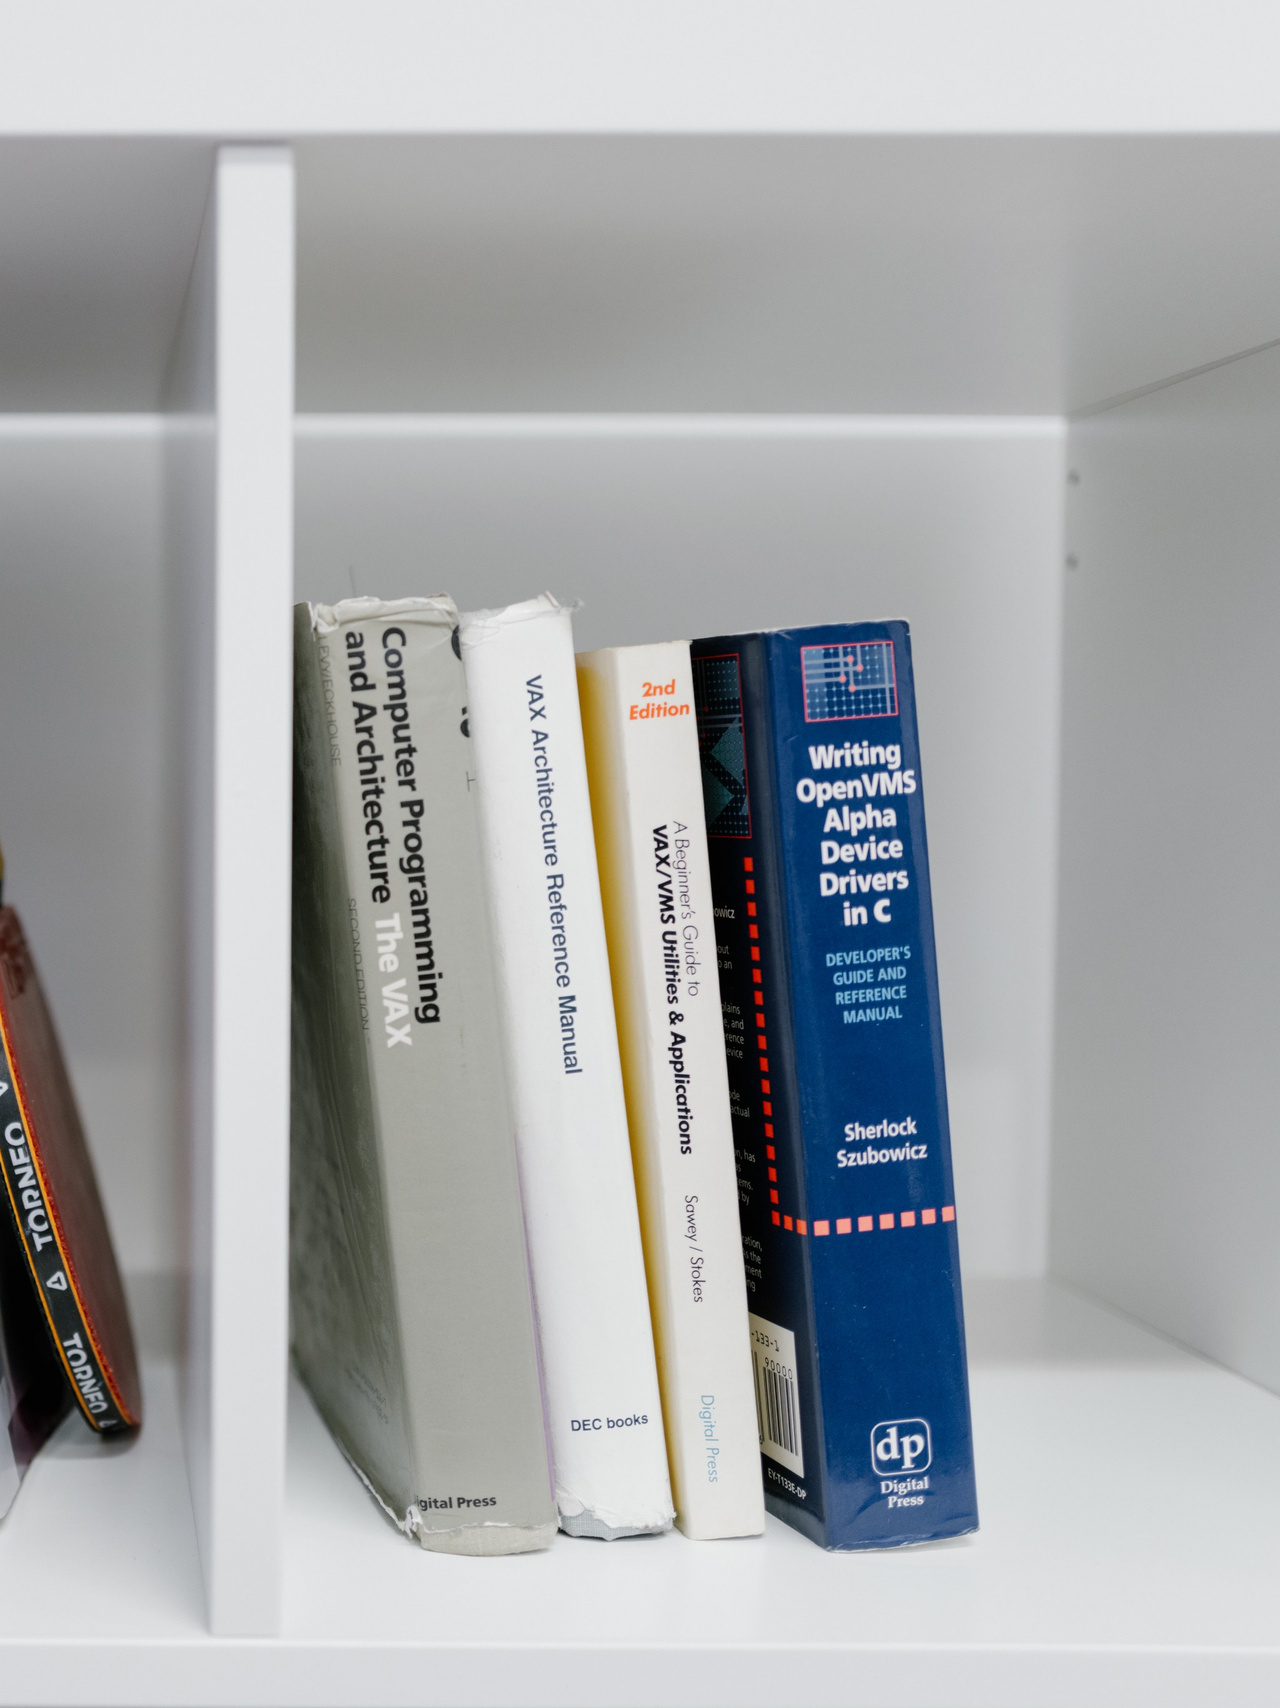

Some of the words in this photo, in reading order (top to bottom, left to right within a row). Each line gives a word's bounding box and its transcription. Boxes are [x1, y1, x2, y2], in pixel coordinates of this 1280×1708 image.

[345, 631, 377, 692] and
[525, 675, 547, 721] VAX
[642, 679, 676, 698] 2nd
[382, 626, 417, 792] Computer
[628, 702, 690, 721] Edition
[808, 741, 902, 770] Writing
[352, 700, 392, 904] Architecture
[531, 729, 559, 867] Architecture
[796, 770, 917, 806] OpenVMS
[673, 821, 688, 835] A
[824, 804, 897, 837] Alpha
[820, 837, 903, 865] Device
[652, 823, 676, 925] VAX/VMS
[673, 838, 698, 920] Beginner's
[820, 869, 909, 896] Drivers
[399, 798, 443, 1024] Programming
[713, 905, 735, 919] owicz
[843, 901, 867, 926] in
[873, 899, 892, 923] C
[375, 912, 404, 973] The
[546, 873, 572, 988] Reference
[348, 898, 362, 965] SECOND
[356, 969, 369, 1030] EDITION
[661, 930, 679, 1005] Utilities
[682, 924, 700, 975] Guide
[826, 946, 911, 967] DEVELOPER'S
[687, 976, 699, 998] to
[833, 968, 873, 986] GUIDE
[878, 966, 907, 983] AND
[381, 978, 412, 1048] VAX
[835, 985, 907, 1005] REFERENCE
[669, 1011, 684, 1026] &
[843, 1006, 903, 1024] MANUAL
[558, 994, 583, 1075] Manual
[668, 1031, 693, 1155] Applications
[844, 1117, 917, 1141] Sherlock
[837, 1143, 928, 1168] Szubowicz
[5, 1122, 53, 1251] TORNEO
[684, 1194, 700, 1243] Sawey
[690, 1257, 706, 1303] Stokes
[765, 1357, 793, 1380] 90000
[571, 1418, 602, 1432] DEC
[606, 1413, 649, 1430] books
[698, 1394, 719, 1442] Digital
[706, 1446, 720, 1483] Press
[876, 1427, 925, 1470] dp
[414, 1494, 453, 1511] igital
[457, 1497, 497, 1508] Press
[880, 1476, 929, 1495] Digital
[887, 1493, 924, 1508] Press
